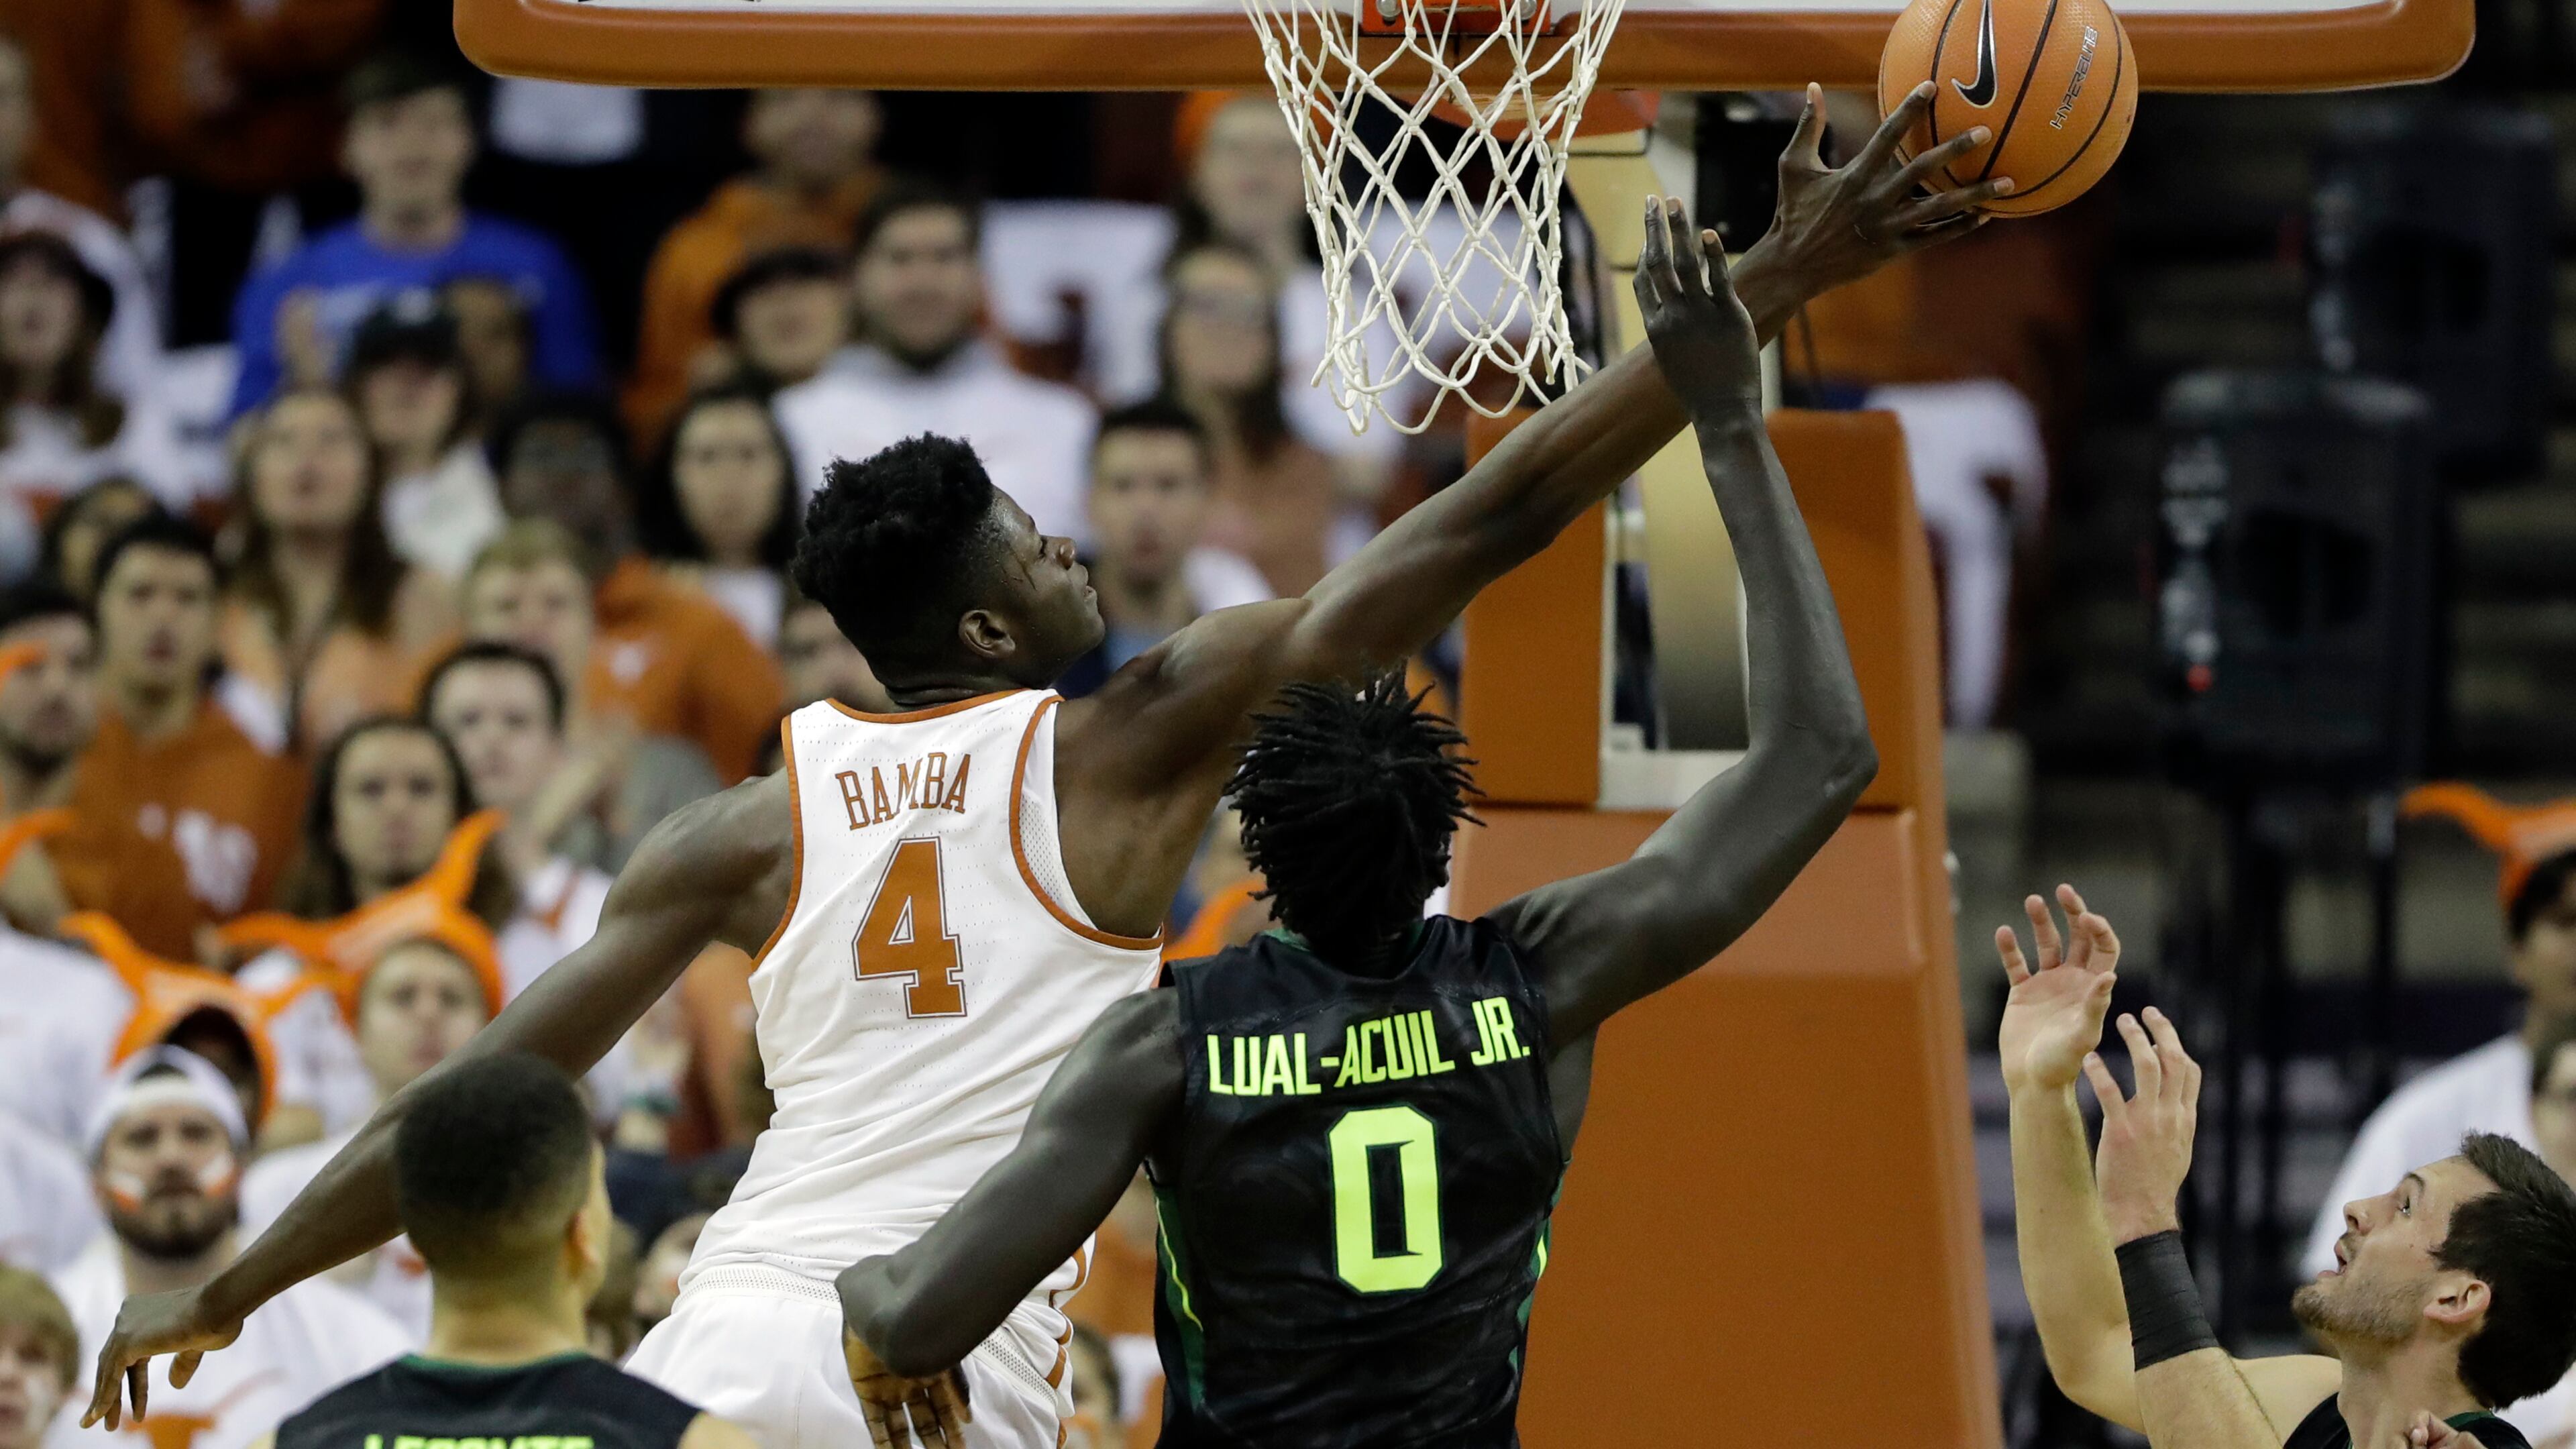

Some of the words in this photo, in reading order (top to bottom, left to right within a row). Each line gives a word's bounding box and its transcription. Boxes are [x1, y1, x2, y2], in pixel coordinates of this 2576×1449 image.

[2050, 25, 2098, 129] HYPERELITE
[835, 752, 971, 830] BAMBA
[851, 836, 967, 1019] 4
[1208, 1010, 1456, 1095] LUAL-ACUIL
[1471, 996, 1530, 1066] JR.
[1328, 1105, 1444, 1295] 0
